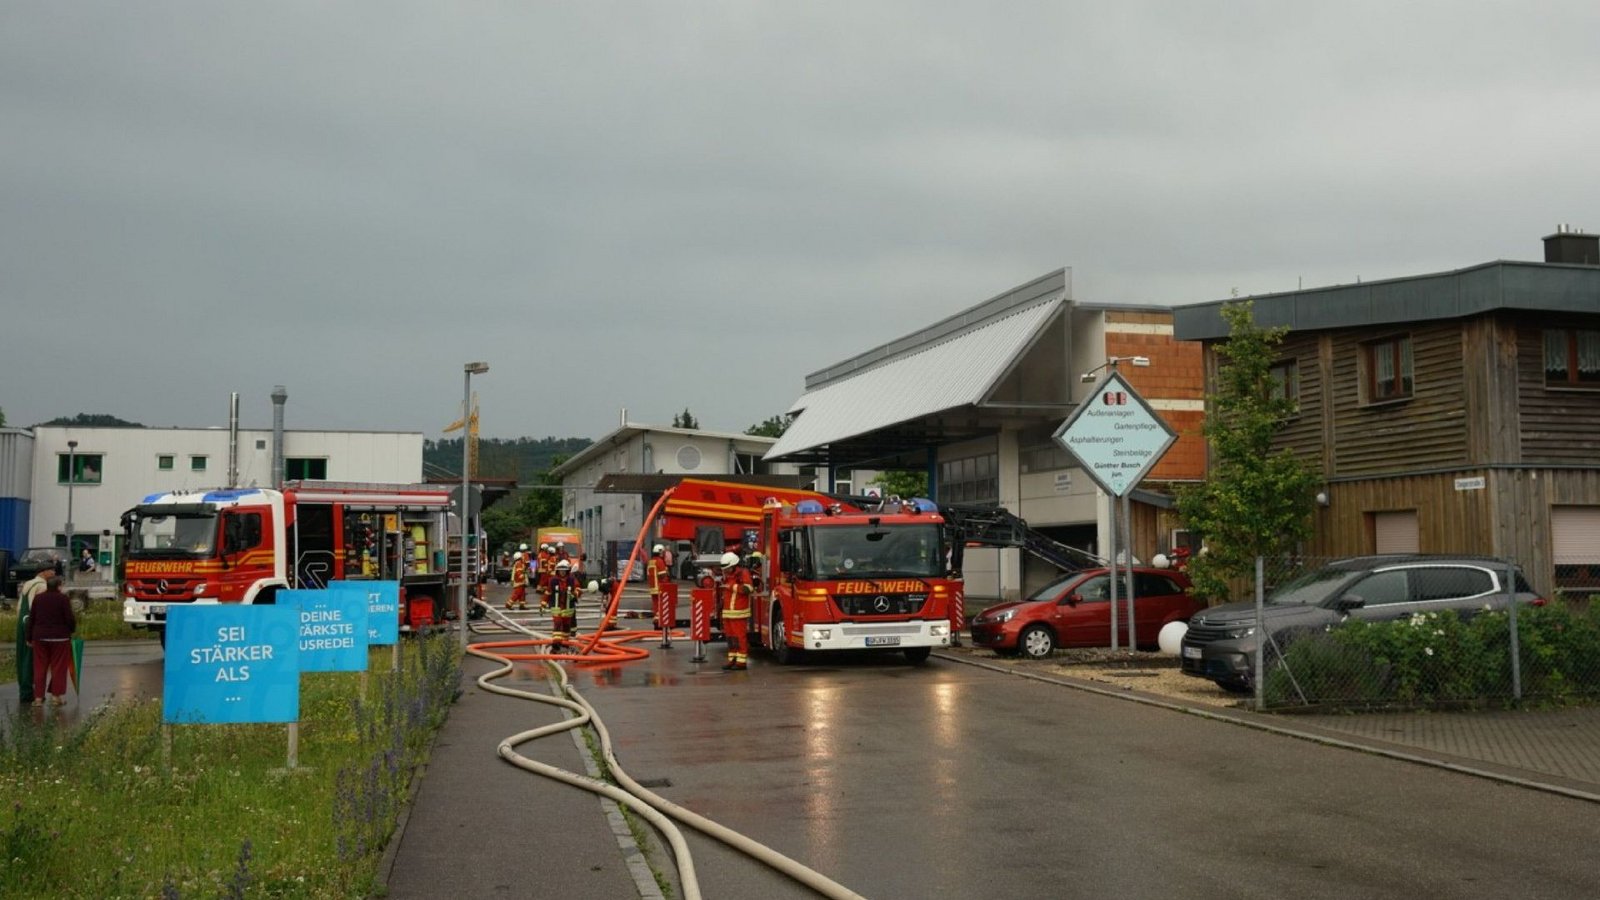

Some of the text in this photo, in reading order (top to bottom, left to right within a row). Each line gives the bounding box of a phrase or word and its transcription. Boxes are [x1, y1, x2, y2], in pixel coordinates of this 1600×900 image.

[1087, 409, 1135, 418] Außenanlagen
[1114, 422, 1157, 431] Gartenpflege
[1069, 436, 1124, 444] Asphaltierungen
[134, 562, 193, 573] FEUERWEHR
[836, 580, 924, 594] FEUERWEHR
[301, 610, 341, 623] DEINE
[218, 627, 245, 642] SEI
[300, 623, 353, 636] TÄRKSTE
[299, 637, 354, 651] USREDE!
[191, 644, 273, 664] STÄRKER
[215, 666, 250, 682] ALS
